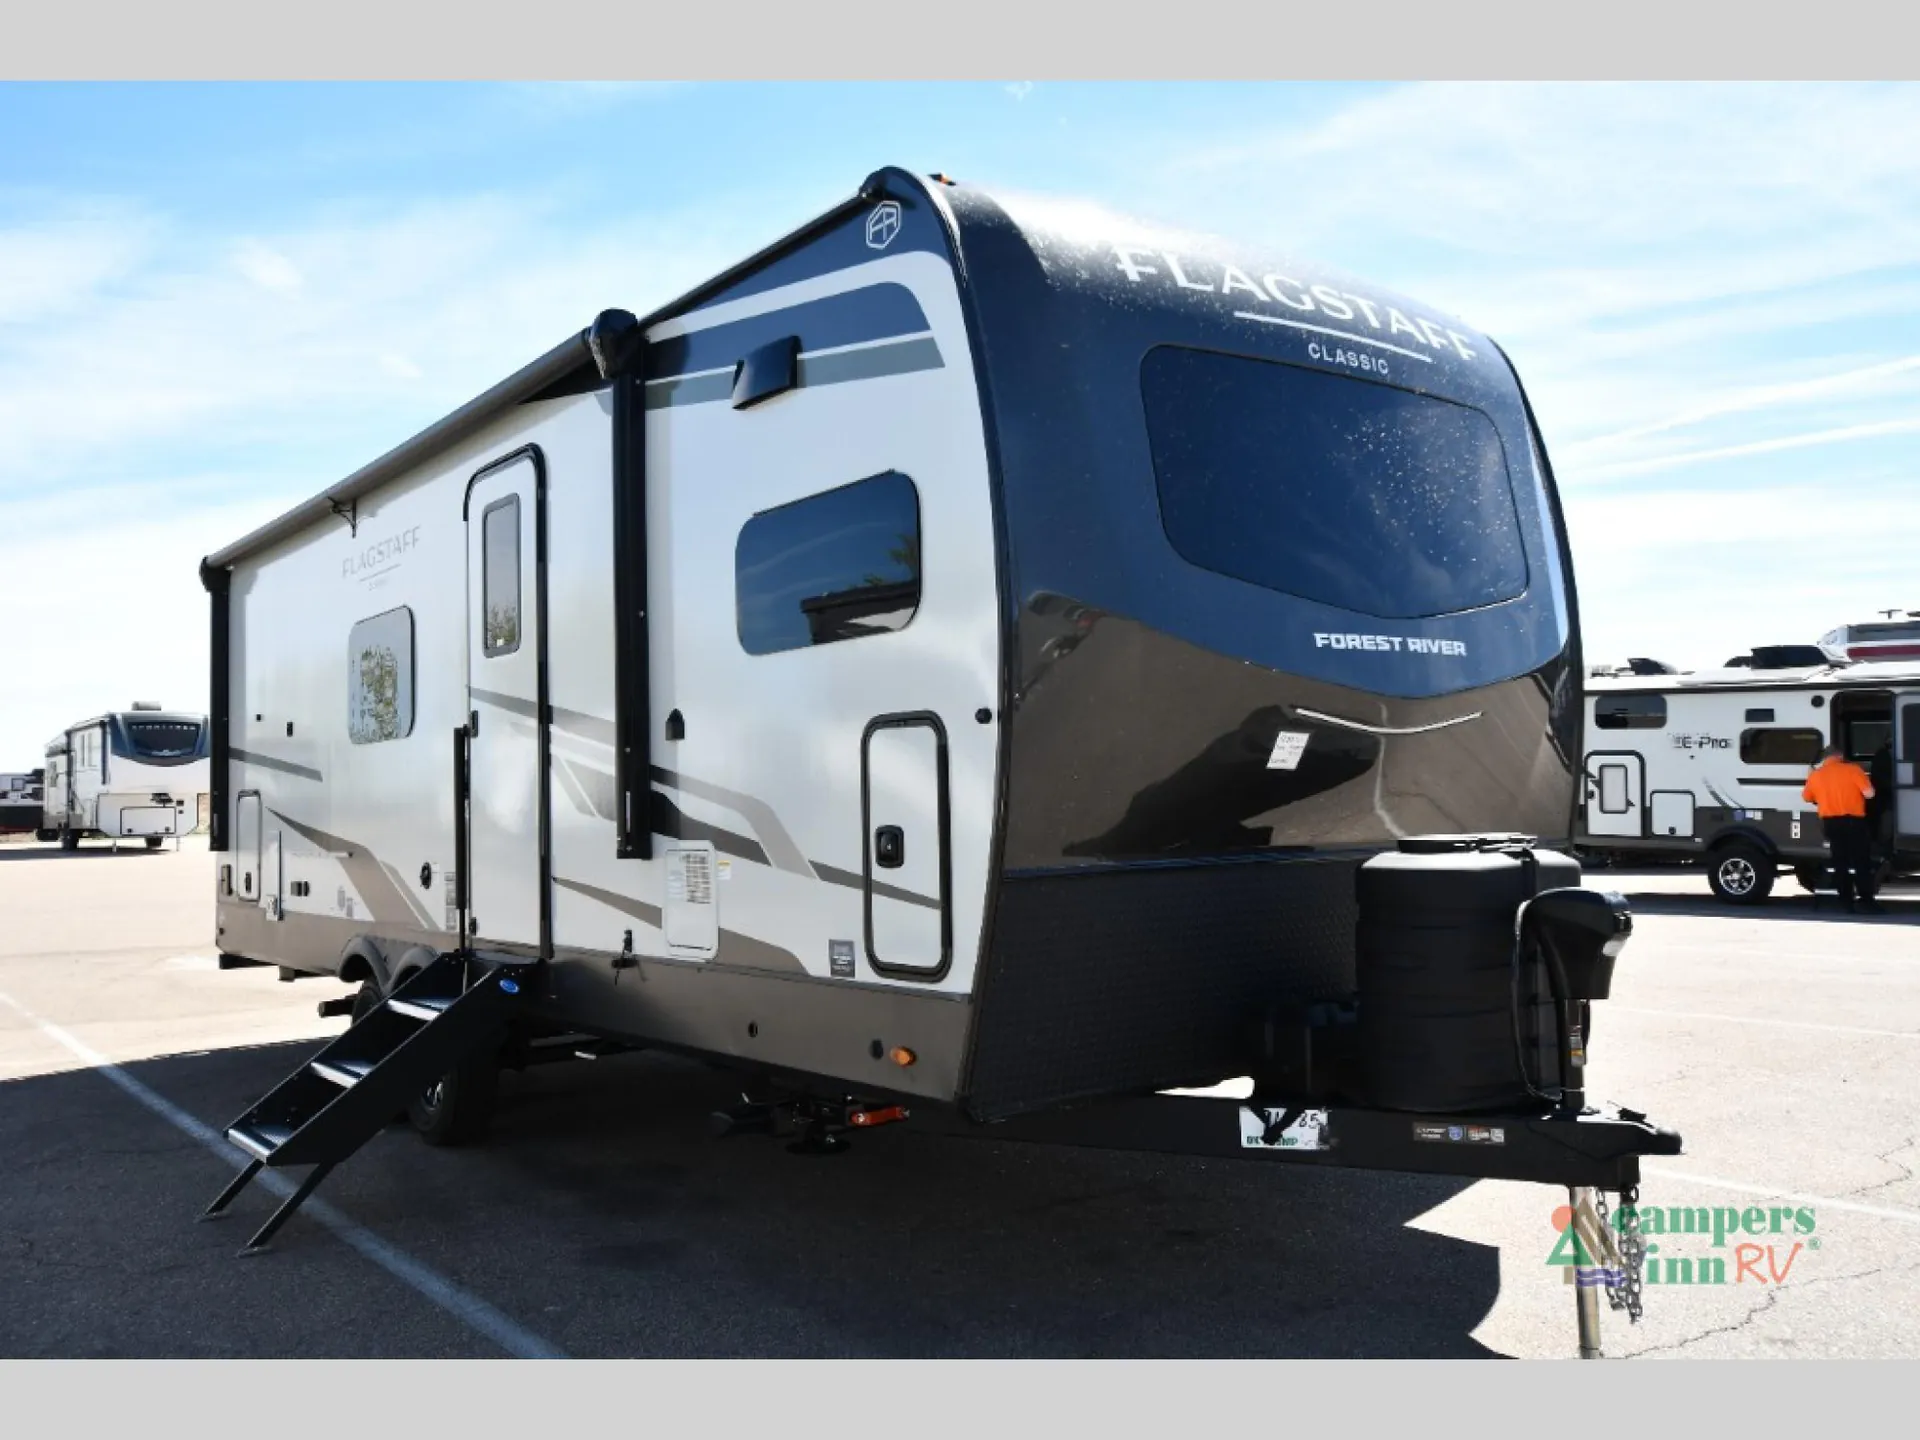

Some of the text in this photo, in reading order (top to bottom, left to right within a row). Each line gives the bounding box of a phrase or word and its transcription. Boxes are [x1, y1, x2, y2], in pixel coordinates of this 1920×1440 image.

[1113, 247, 1478, 361] FLAGSTAFF
[1308, 342, 1389, 375] CLASSIC
[341, 525, 421, 578] FLAGSTAFF
[1313, 632, 1467, 656] FOREST RIVER
